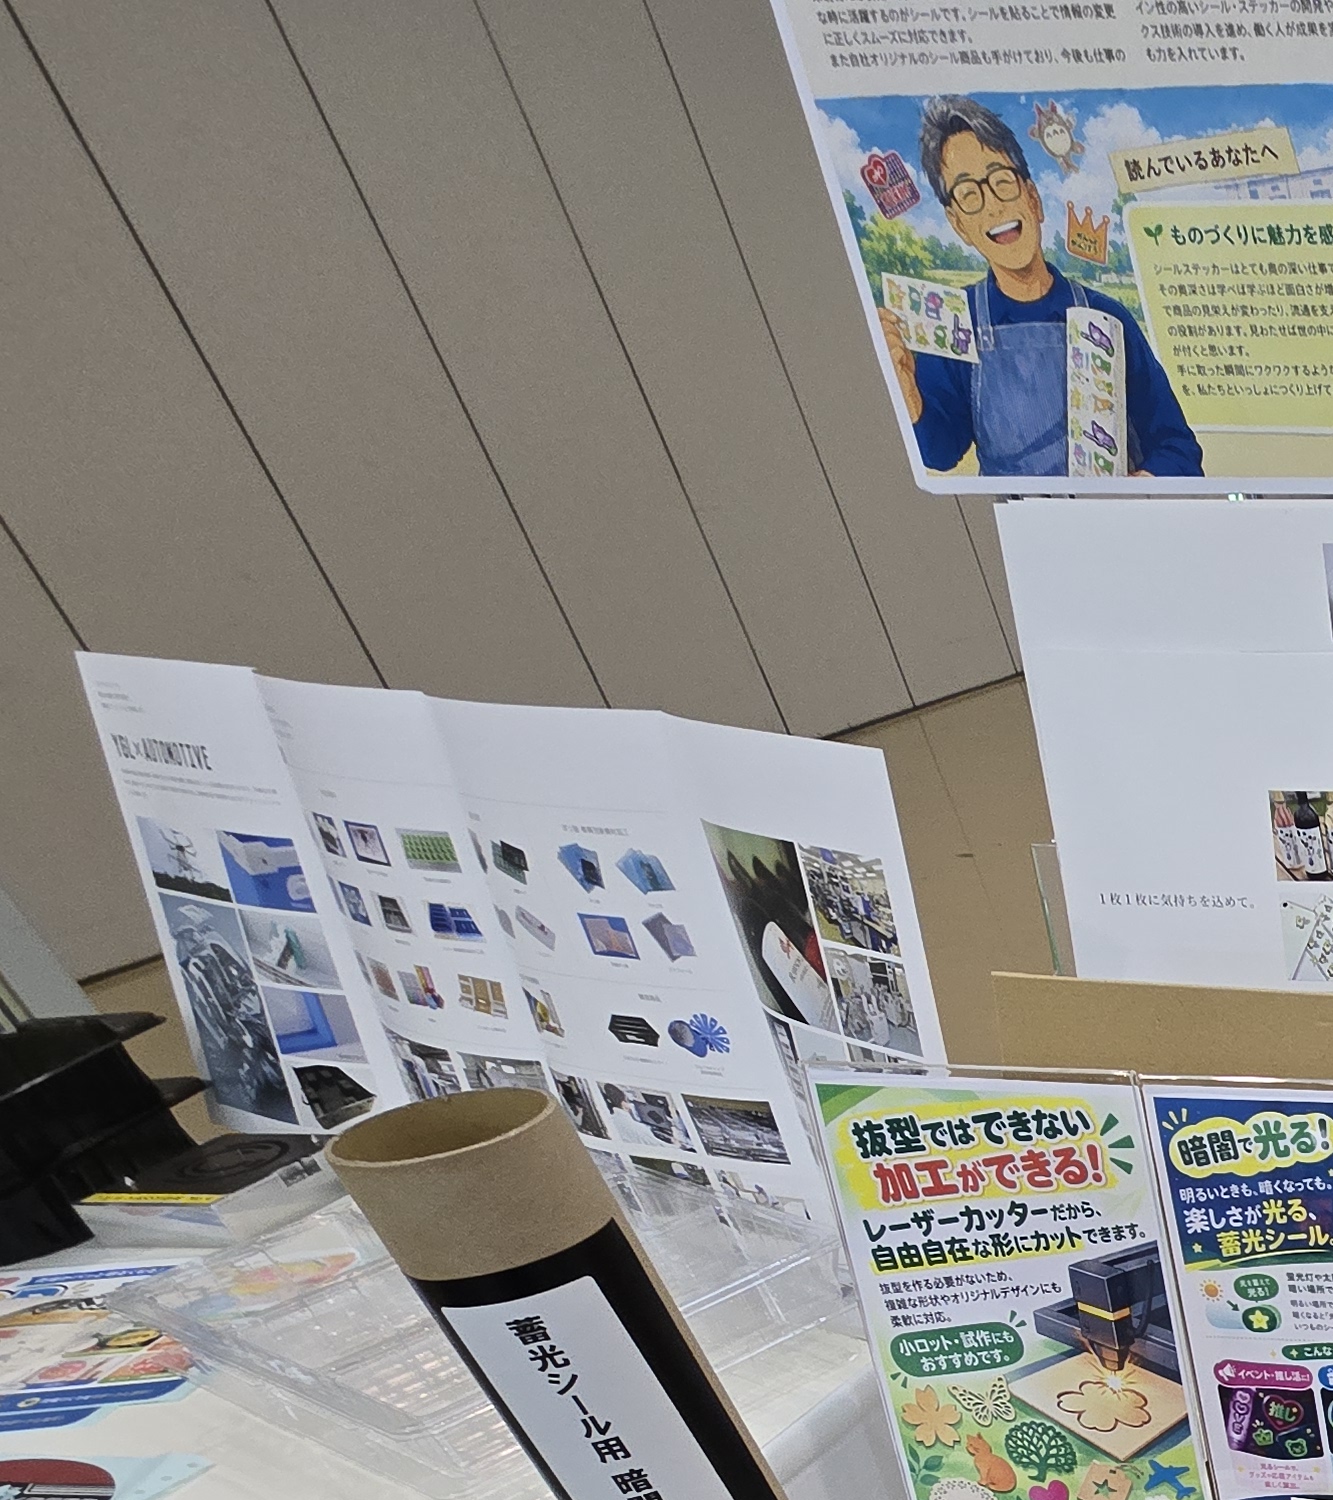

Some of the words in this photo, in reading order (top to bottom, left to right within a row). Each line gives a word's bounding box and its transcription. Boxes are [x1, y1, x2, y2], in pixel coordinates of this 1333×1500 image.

[1123, 142, 1280, 181] 読んでいるあなたへ
[852, 1108, 1092, 1159] 抜型ではできない
[1177, 1117, 1330, 1167] 暗闇で光る!
[873, 1144, 1104, 1203] 加工ができる!
[864, 1200, 1103, 1243] レーザーカッターだから、
[1184, 1199, 1318, 1235] 楽しさが光る、
[871, 1222, 1147, 1271] 自由自在な形にカットできます。
[890, 1310, 954, 1328] 柔軟に対応。
[899, 1330, 1014, 1357] 小ロット・試作にも
[920, 1348, 1012, 1373] おすすめです。
[504, 1315, 632, 1463] 蓄光シール用
